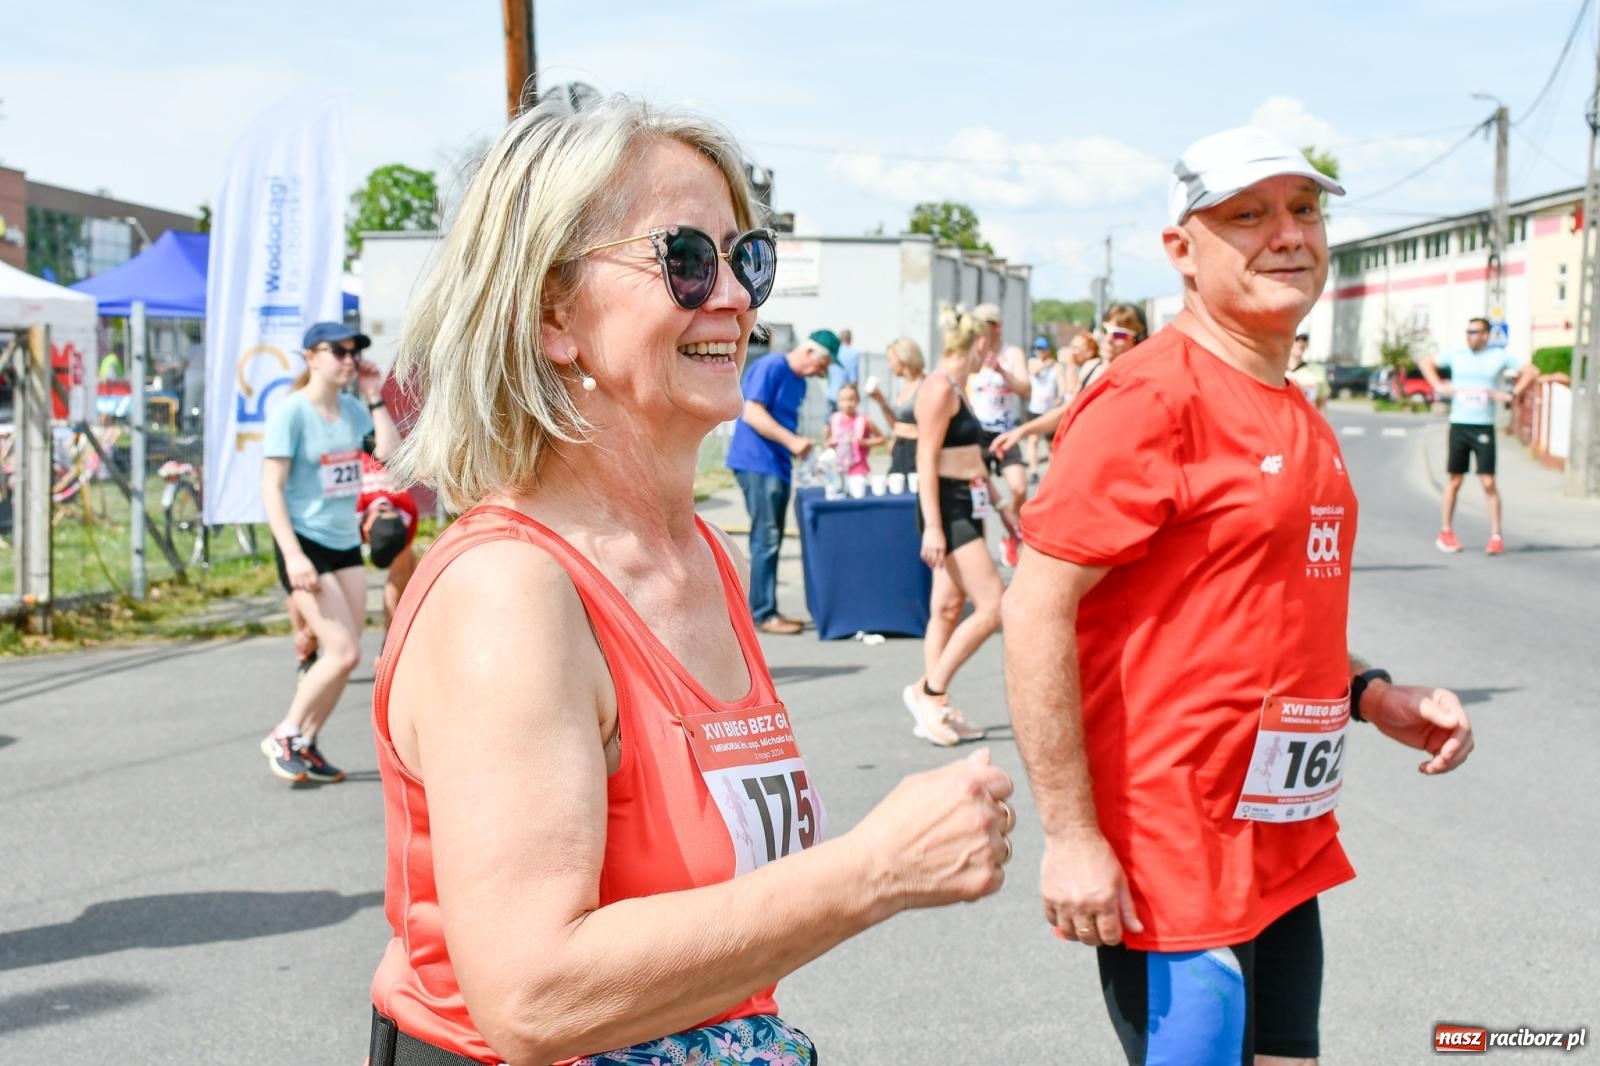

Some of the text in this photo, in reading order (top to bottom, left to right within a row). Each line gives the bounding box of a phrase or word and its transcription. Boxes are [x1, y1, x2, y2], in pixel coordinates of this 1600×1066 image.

[263, 176, 288, 294] Wodociągi
[1260, 455, 1283, 474] 4F
[1281, 703, 1303, 715] XVI
[701, 722, 726, 741] XVI
[723, 719, 748, 738] BIEG
[748, 715, 775, 735] BEZ
[771, 748, 784, 758] 2024
[1283, 734, 1345, 789] 162
[742, 770, 815, 862] 175
